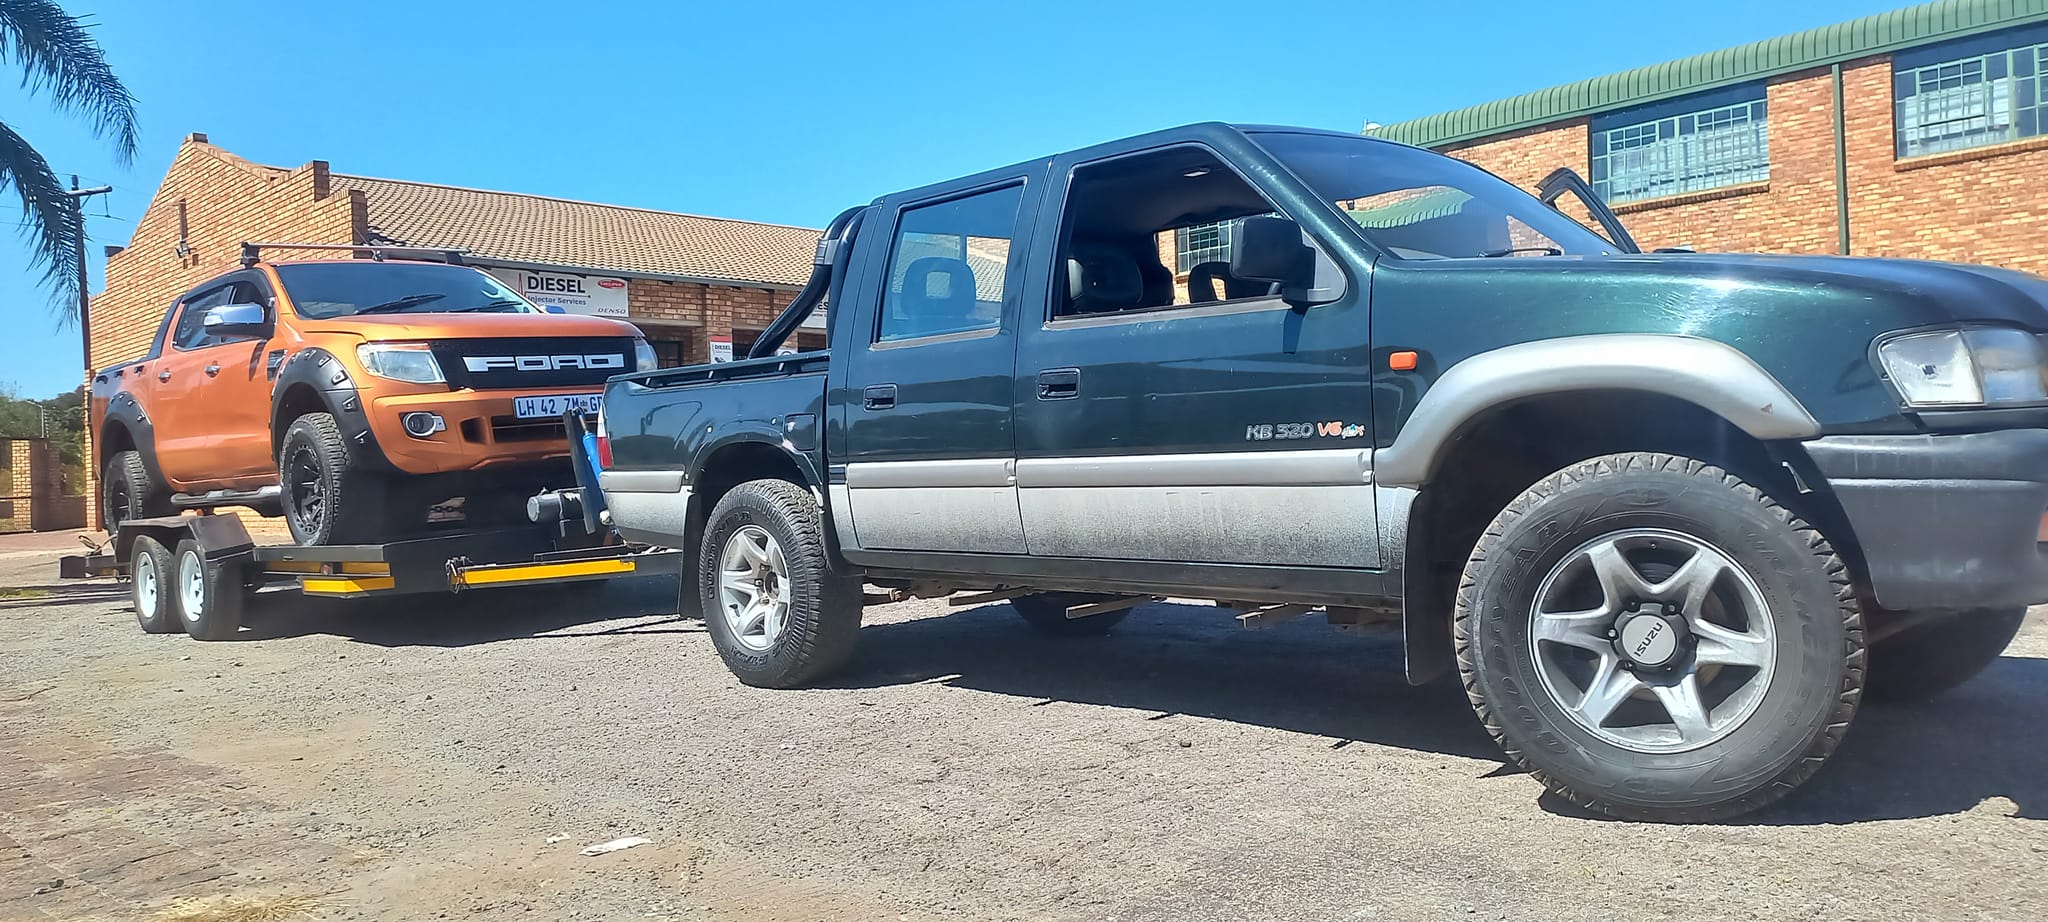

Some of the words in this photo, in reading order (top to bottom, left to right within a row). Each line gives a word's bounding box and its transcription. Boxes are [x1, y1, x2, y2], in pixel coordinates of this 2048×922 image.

[527, 276, 586, 294] DIESEL
[557, 297, 587, 306] Services
[597, 307, 626, 315] DENSO
[463, 354, 624, 372] FORD
[517, 399, 536, 416] LH
[540, 398, 557, 415] 42
[1245, 424, 1274, 441] KB
[1274, 422, 1315, 440] 320
[1317, 421, 1343, 437] V6
[1633, 622, 1663, 657] ISUZU
